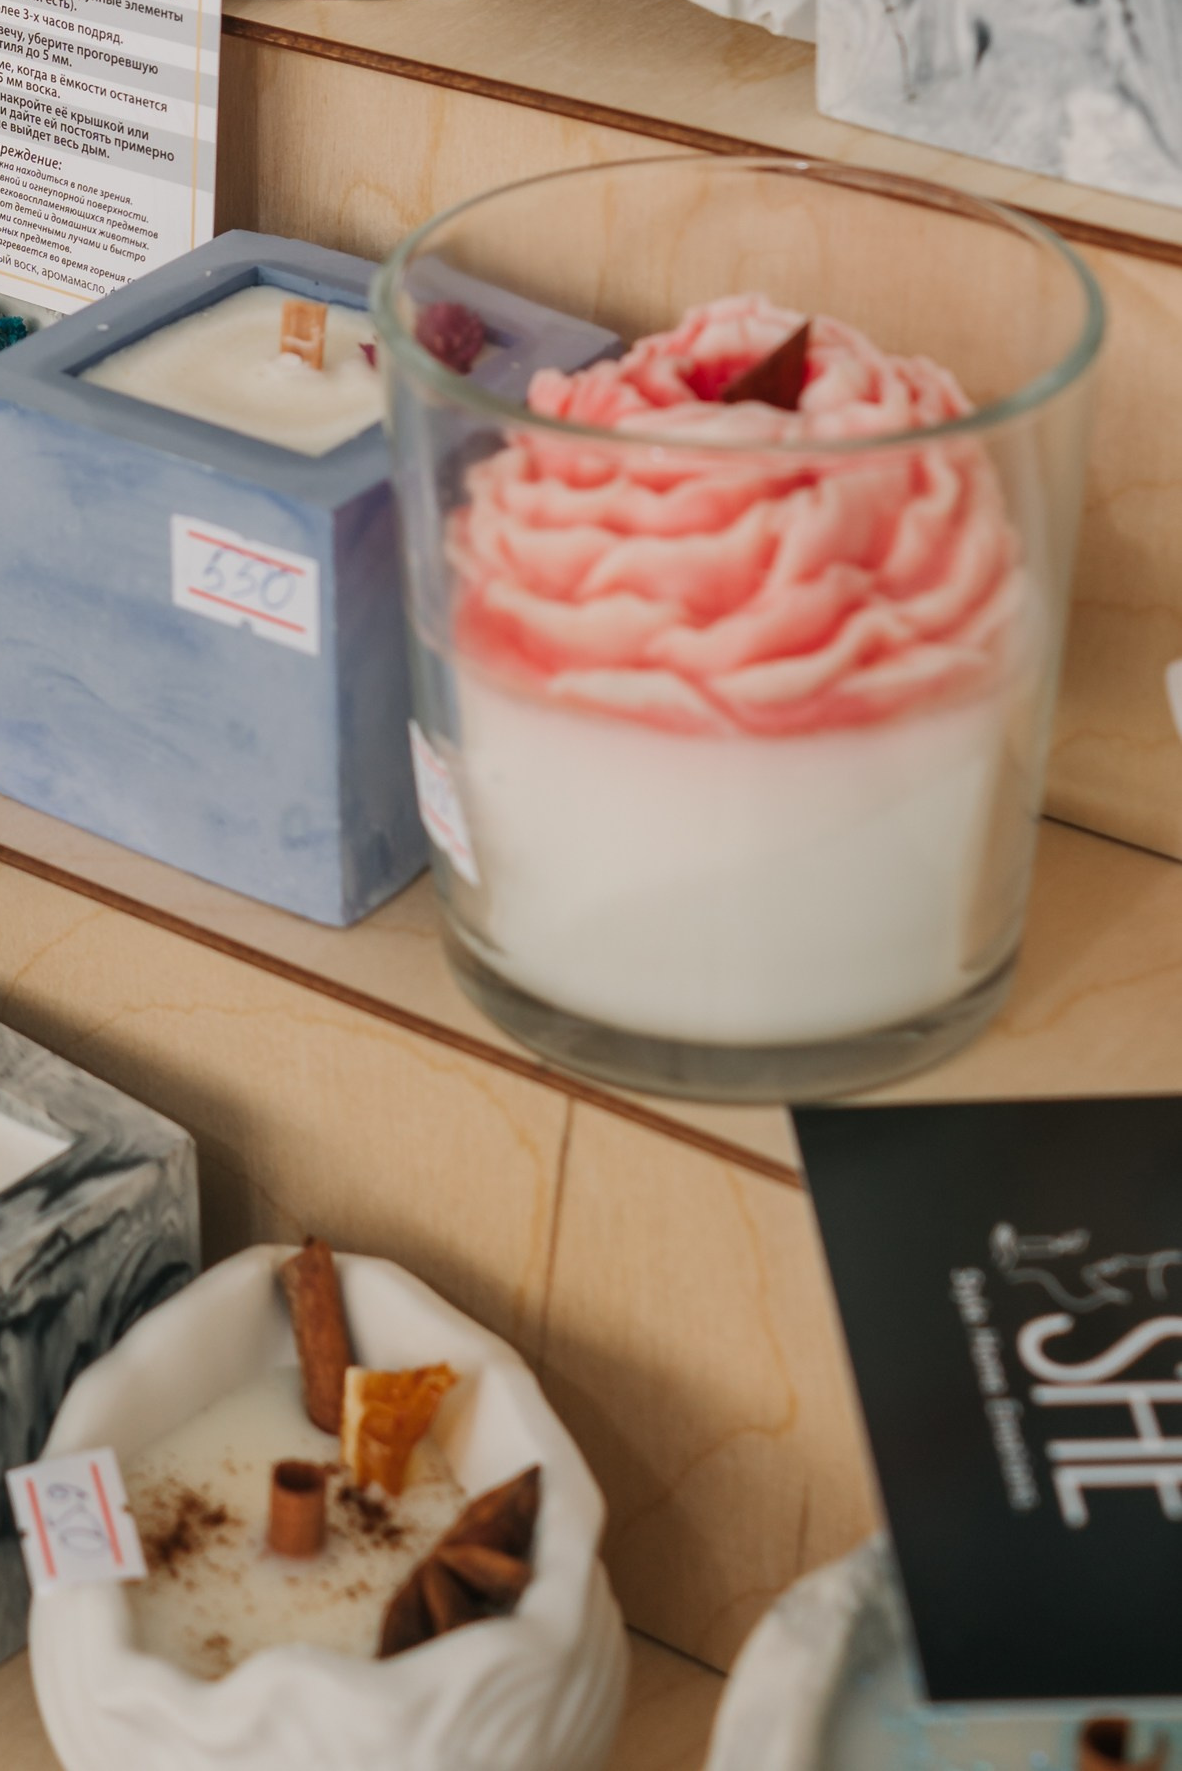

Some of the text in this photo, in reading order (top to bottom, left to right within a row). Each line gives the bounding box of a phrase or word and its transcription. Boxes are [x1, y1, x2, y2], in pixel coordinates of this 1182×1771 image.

[22, 7, 40, 24] 3-х
[42, 15, 75, 32] часов
[77, 24, 124, 46] подряд.
[124, 0, 184, 23] элементы
[25, 46, 41, 60] до
[51, 53, 73, 68] мм.
[27, 31, 75, 54] уберите
[76, 45, 159, 75] прогоревшую
[6, 75, 24, 89] мм
[25, 80, 61, 99] воска.
[16, 64, 48, 83] когда
[59, 73, 107, 97] ёмкости
[109, 89, 168, 113] останется
[0, 91, 54, 119] накройте
[54, 105, 68, 120] её
[70, 111, 125, 135] крышкой
[127, 126, 149, 141] или
[8, 106, 42, 127] дайте
[43, 116, 58, 131] ей
[60, 122, 112, 145] постоять
[113, 137, 175, 162] примерно
[8, 117, 52, 143] выйдет
[53, 134, 80, 150] весь
[80, 142, 110, 159] дым.
[13, 165, 69, 188] находиться
[76, 183, 99, 196] поле
[98, 189, 133, 206] зрения.
[28, 180, 86, 205] огнеупорной
[85, 198, 150, 224] поверхности.
[0, 198, 14, 211] от
[14, 201, 43, 219] детей
[50, 211, 98, 236] домашних
[97, 228, 150, 251] животных.
[12, 216, 67, 239] солнечными
[66, 232, 102, 250] лучами
[109, 243, 147, 263] быстро
[17, 228, 73, 255] предметов.
[105, 213, 159, 240] предметов
[13, 258, 40, 276] воск,
[41, 267, 108, 297] аромамасло,
[48, 250, 61, 263] во
[58, 253, 89, 273] время
[89, 265, 126, 284] горения
[202, 546, 297, 612] 550
[1017, 1313, 1182, 1529] SHE
[46, 1481, 112, 1560] 650
